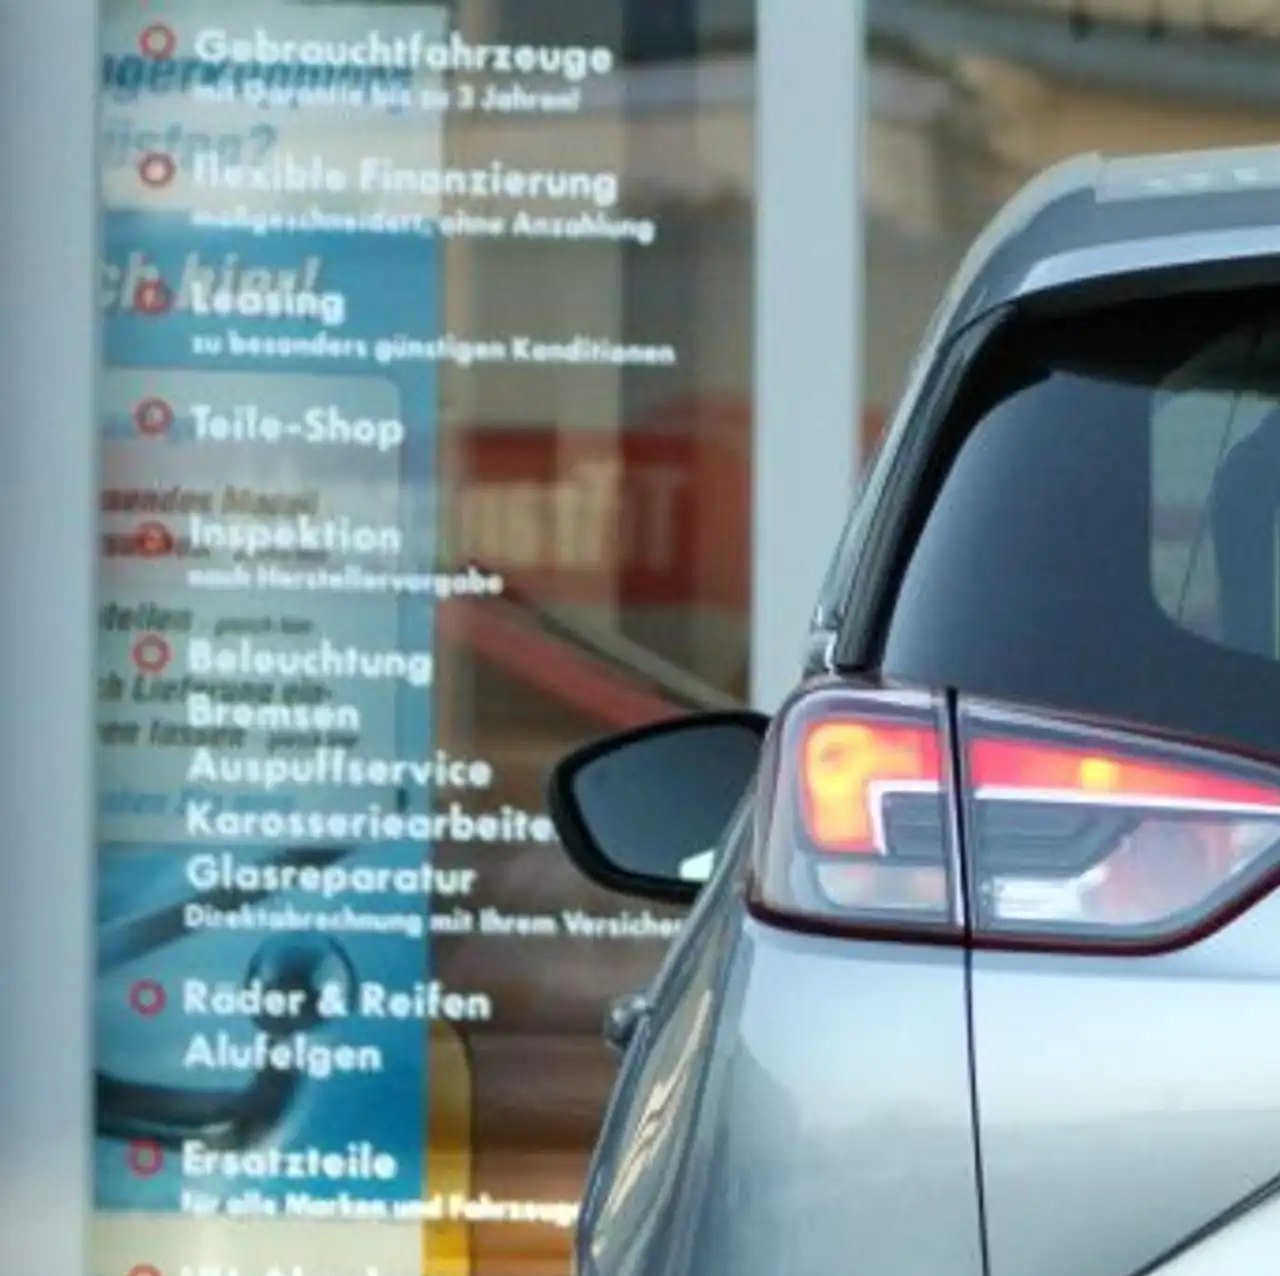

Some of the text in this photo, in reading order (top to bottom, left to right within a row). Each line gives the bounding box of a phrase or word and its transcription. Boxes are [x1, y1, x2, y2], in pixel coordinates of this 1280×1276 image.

[194, 28, 613, 82] Gebrauchtfahrzeuge
[190, 82, 234, 104] mit
[243, 81, 363, 105] Garantie
[370, 80, 412, 107] bis
[456, 83, 475, 112] 3
[192, 152, 618, 208] flexible Finanzierung
[440, 209, 505, 239] ohne
[511, 209, 656, 246] Anzahlung
[190, 281, 347, 325] Leasing
[192, 328, 677, 368] zu besonders günstigen Konditionen
[189, 402, 405, 451] Teile-Shop
[189, 512, 403, 557] Inspektion
[187, 563, 504, 601] nach Herstellervorgabe
[186, 637, 434, 687] Beleuchtung
[185, 692, 361, 733] Bremsen
[186, 747, 493, 791] Auspuffservice
[186, 799, 558, 843] Karosseriearbeite
[185, 851, 479, 898] Glasreparatur
[184, 902, 422, 938] Direktabrechnung
[430, 906, 474, 934] mit
[480, 906, 558, 936] Ihrem
[317, 980, 349, 1018] &
[360, 978, 493, 1020] Reifen
[182, 1030, 385, 1079] Alufelgen
[181, 1137, 398, 1180] Ersatzteile
[226, 1187, 276, 1216] alle
[284, 1190, 389, 1220] Marken
[393, 1192, 443, 1221] und
[449, 1191, 582, 1228] Fahrzeug
